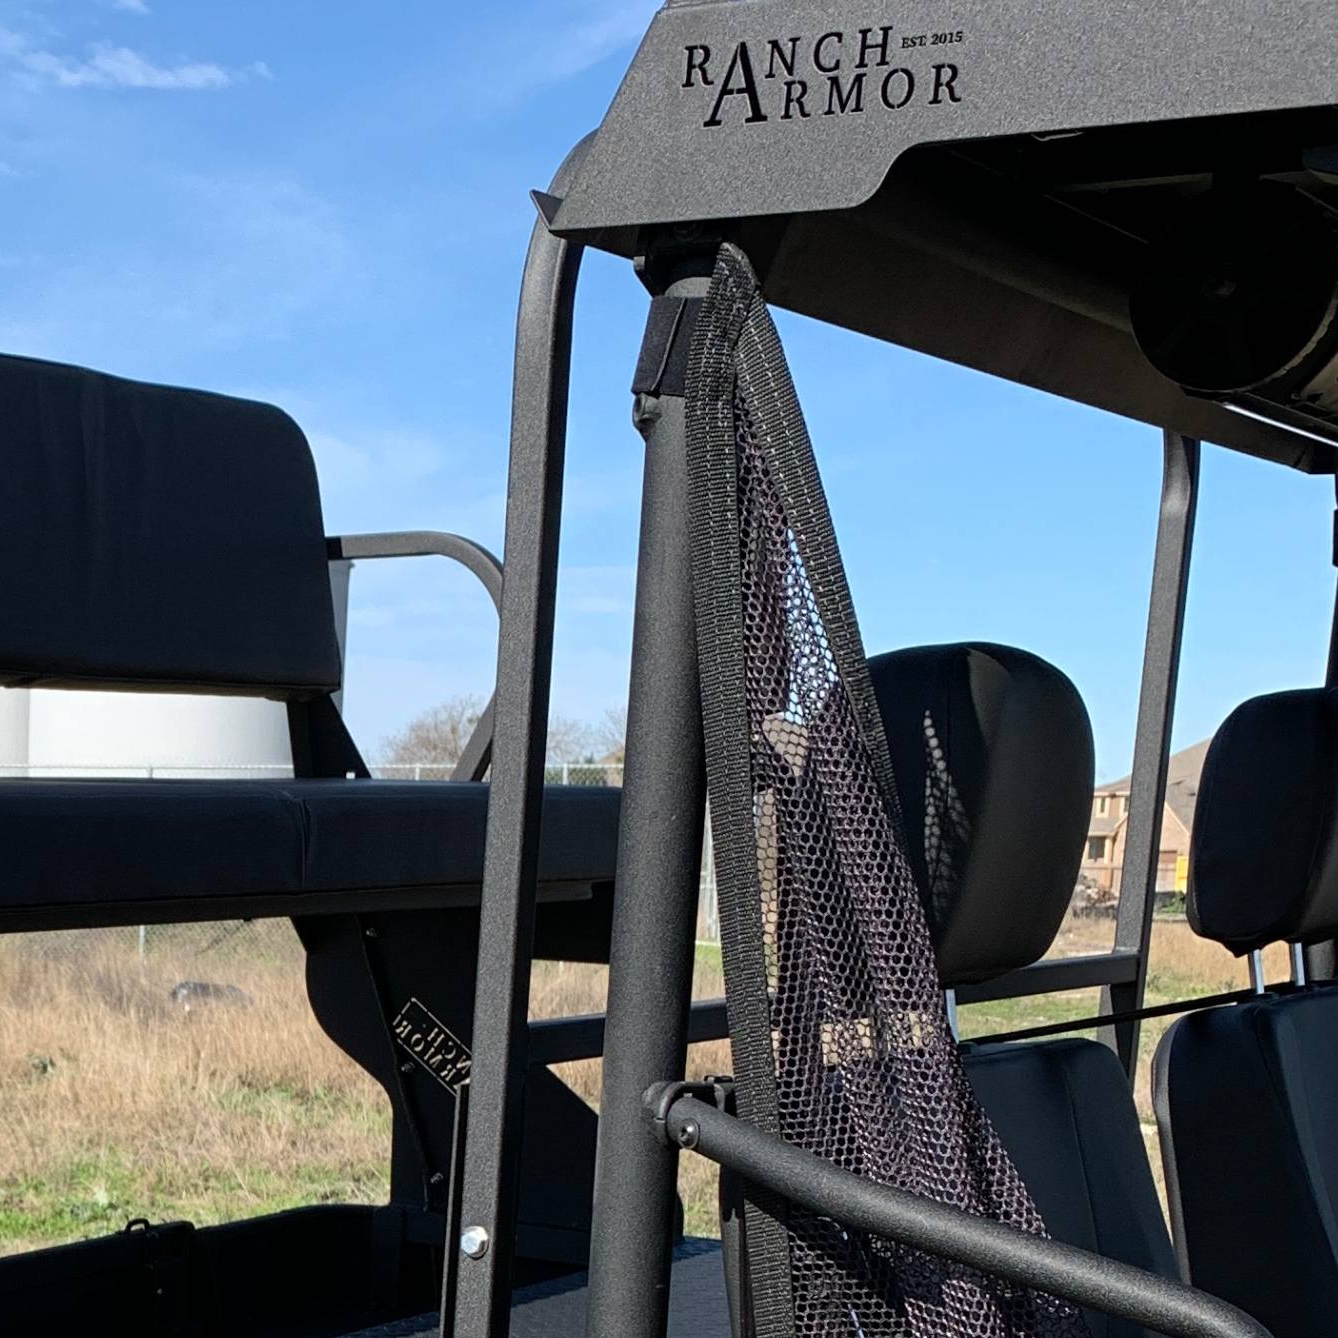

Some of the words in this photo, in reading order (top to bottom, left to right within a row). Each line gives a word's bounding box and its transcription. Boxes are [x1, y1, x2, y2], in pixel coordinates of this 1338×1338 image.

[681, 26, 893, 128] RANCH
[931, 31, 963, 45] 2015
[703, 41, 962, 128] ARMOR
